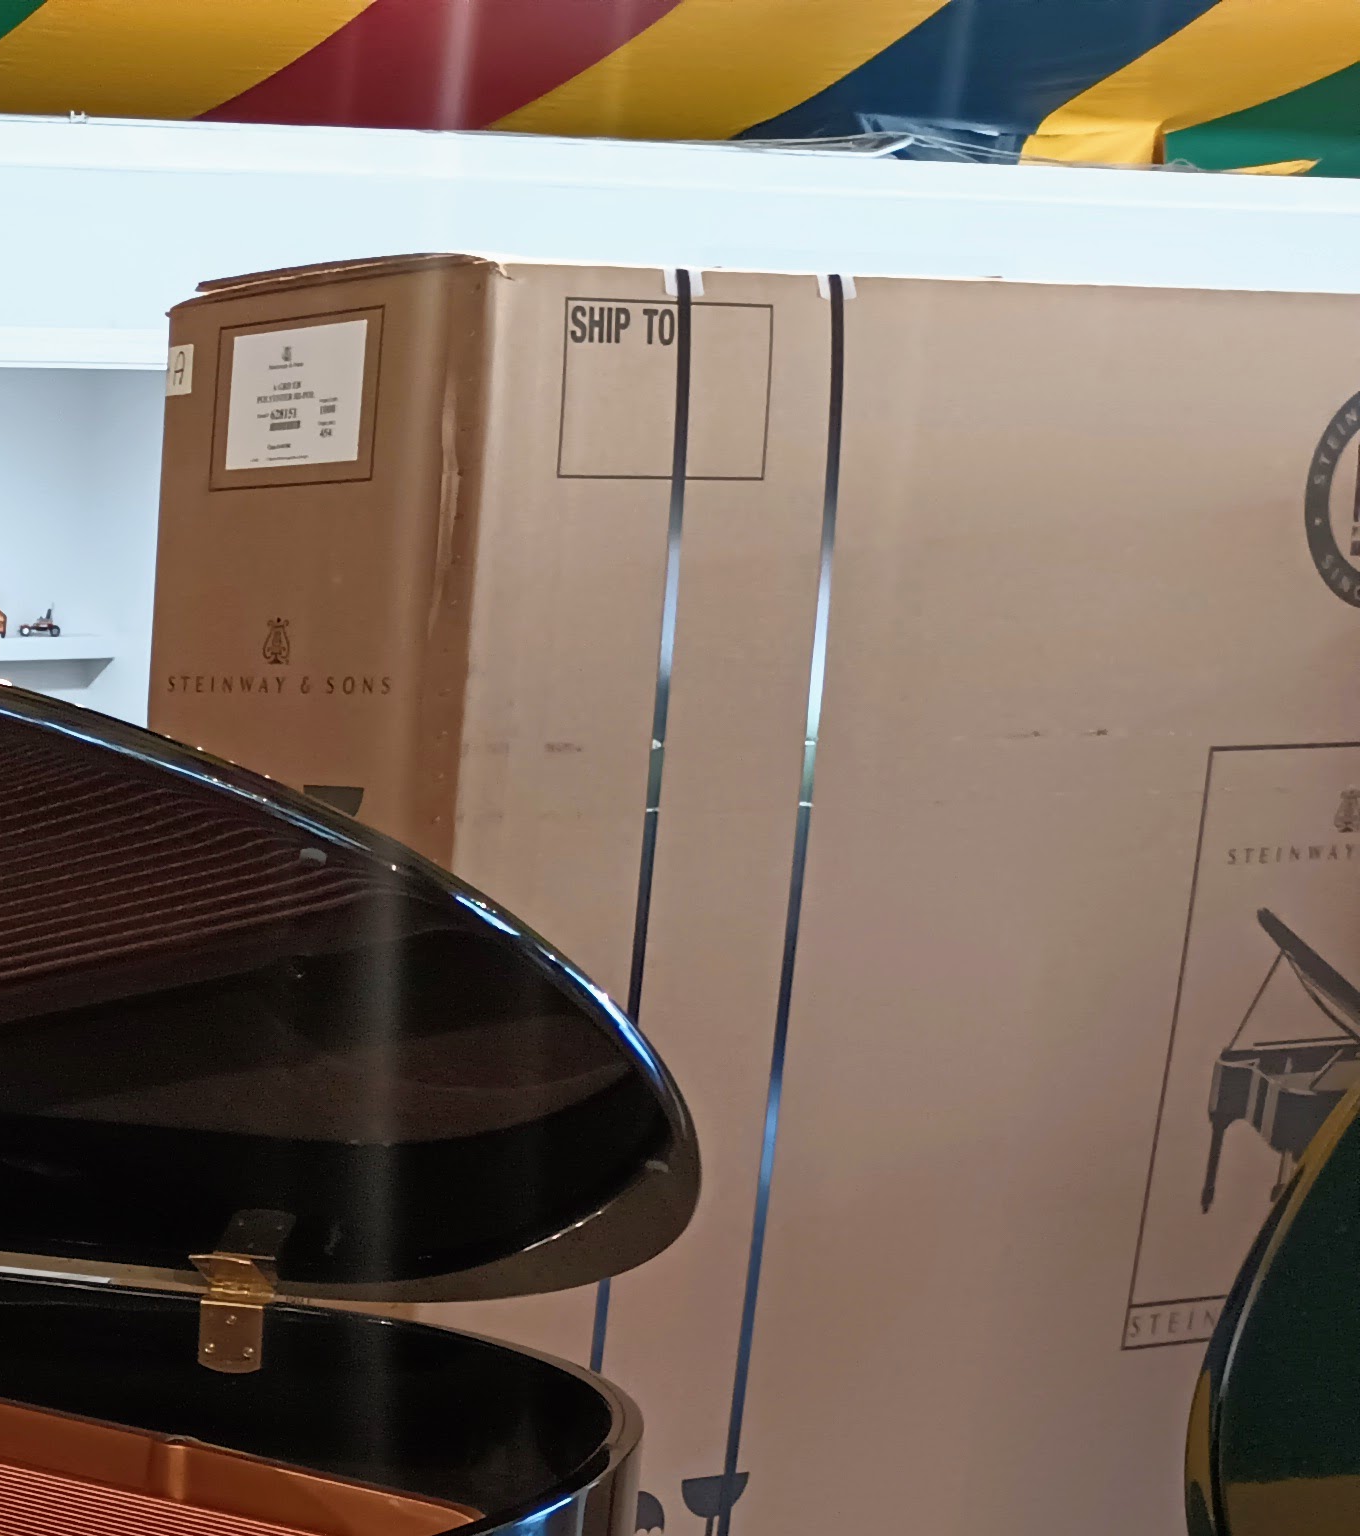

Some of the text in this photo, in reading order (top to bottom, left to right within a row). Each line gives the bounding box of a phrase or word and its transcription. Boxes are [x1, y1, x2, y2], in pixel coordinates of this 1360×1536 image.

[570, 305, 675, 346] SHIP TO
[166, 675, 393, 695] STEINWAY & SONS
[1226, 843, 1355, 865] STEINWAY
